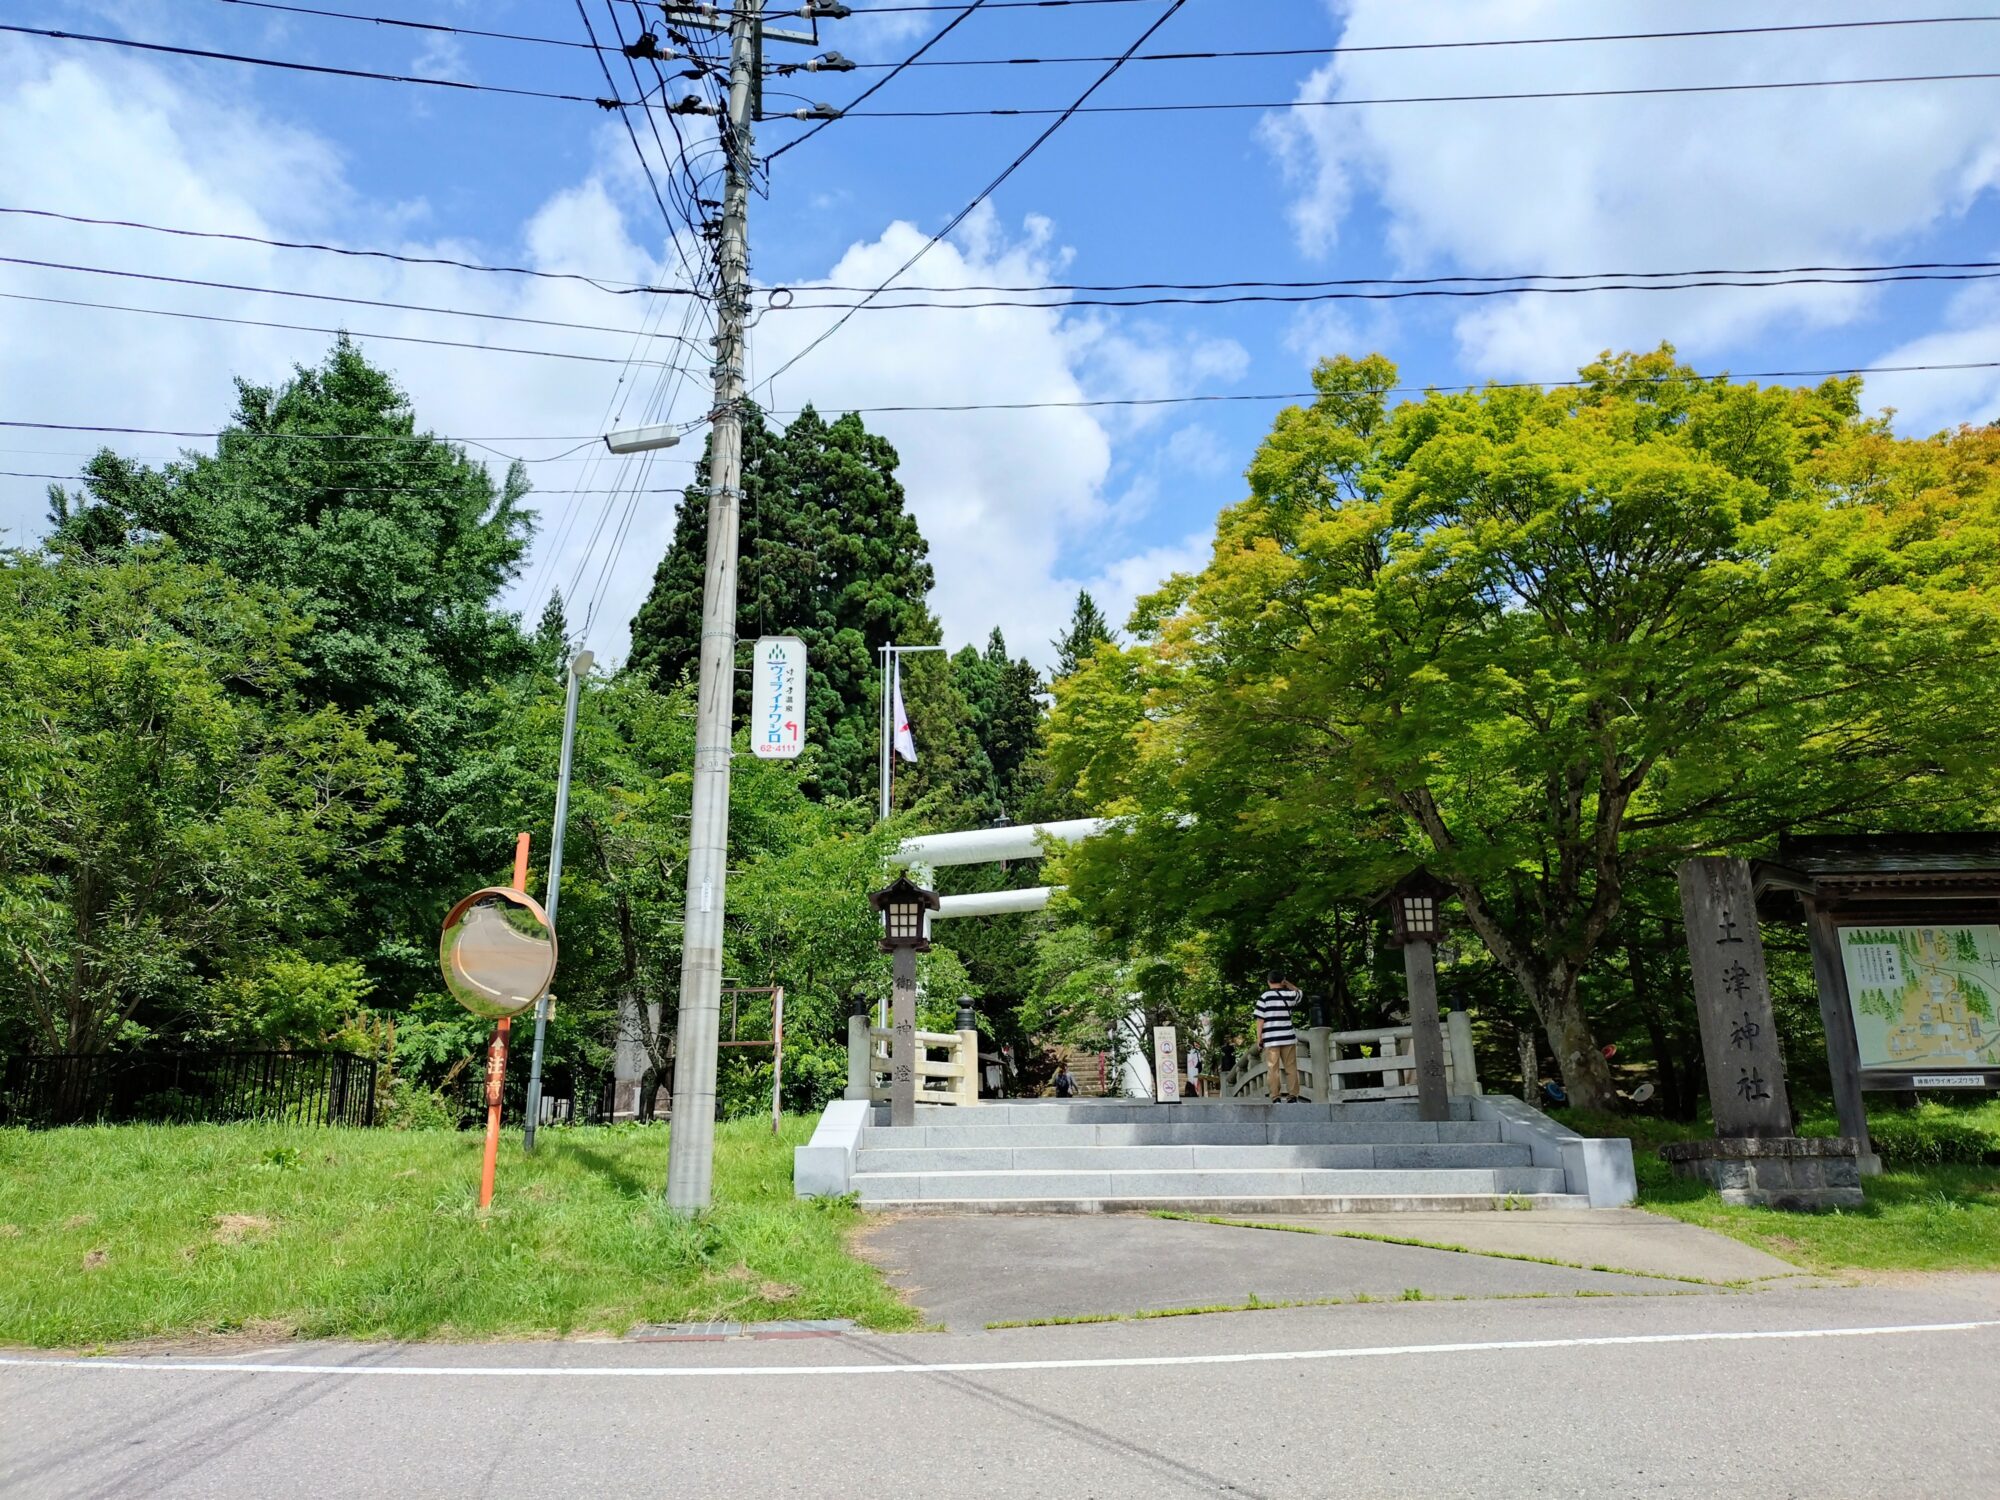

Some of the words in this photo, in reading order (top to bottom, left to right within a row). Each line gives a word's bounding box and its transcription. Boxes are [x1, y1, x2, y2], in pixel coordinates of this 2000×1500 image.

[1716, 911, 1771, 1102] 土津神社
[486, 1057, 504, 1100] 注意
